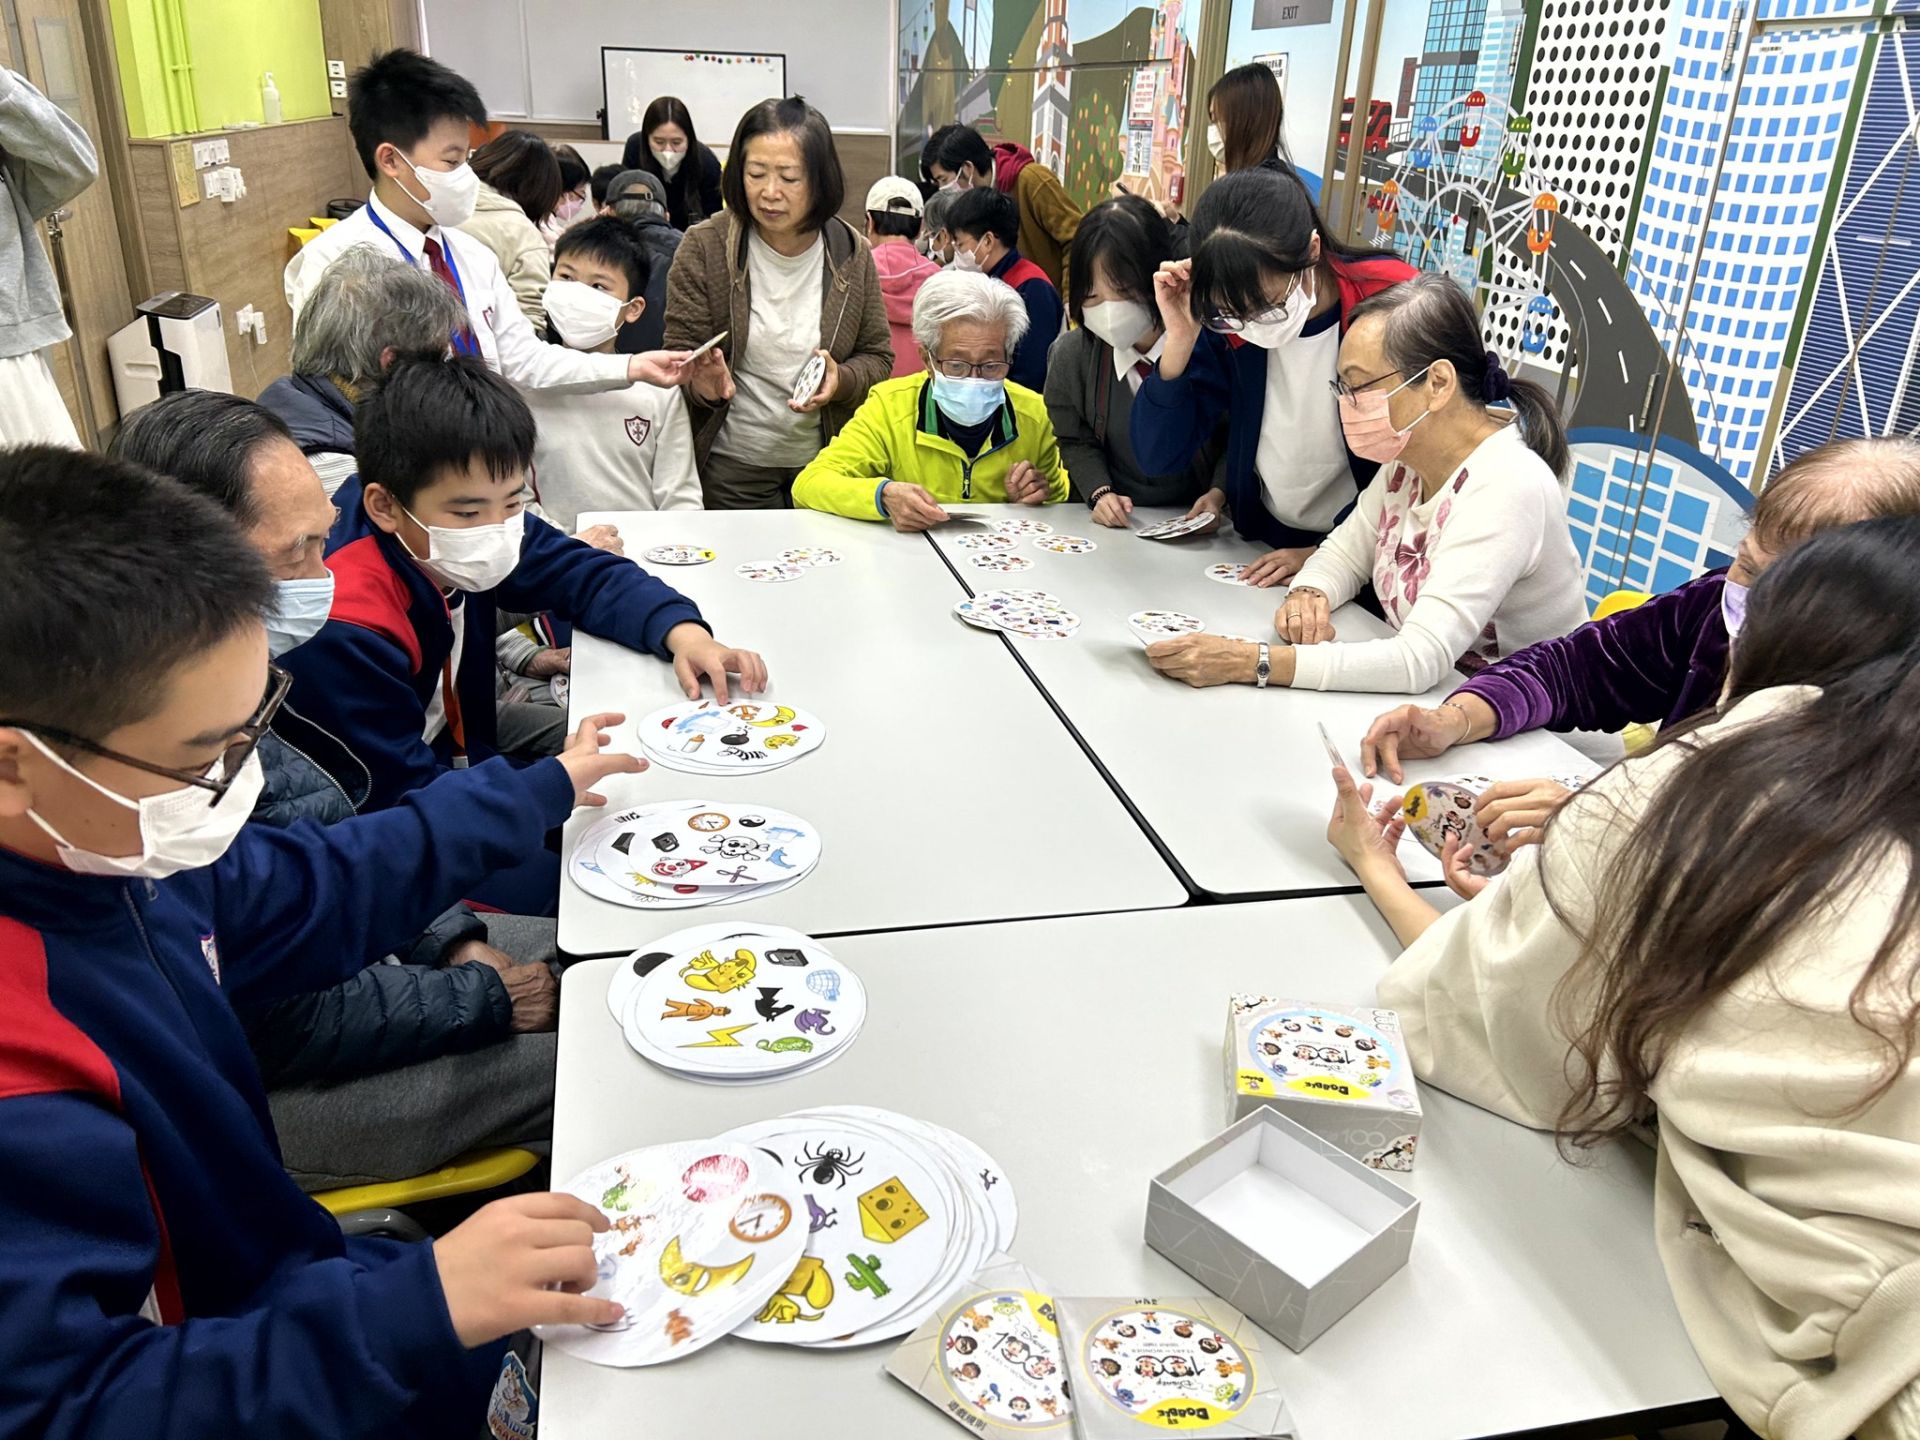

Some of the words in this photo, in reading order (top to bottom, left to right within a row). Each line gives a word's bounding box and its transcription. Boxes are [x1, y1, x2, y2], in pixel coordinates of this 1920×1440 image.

[1282, 6, 1299, 20] EXIT
[1021, 1325, 1051, 1355] Disney
[1156, 1378, 1201, 1390] Disney
[947, 1401, 987, 1431] 遊戲規則
